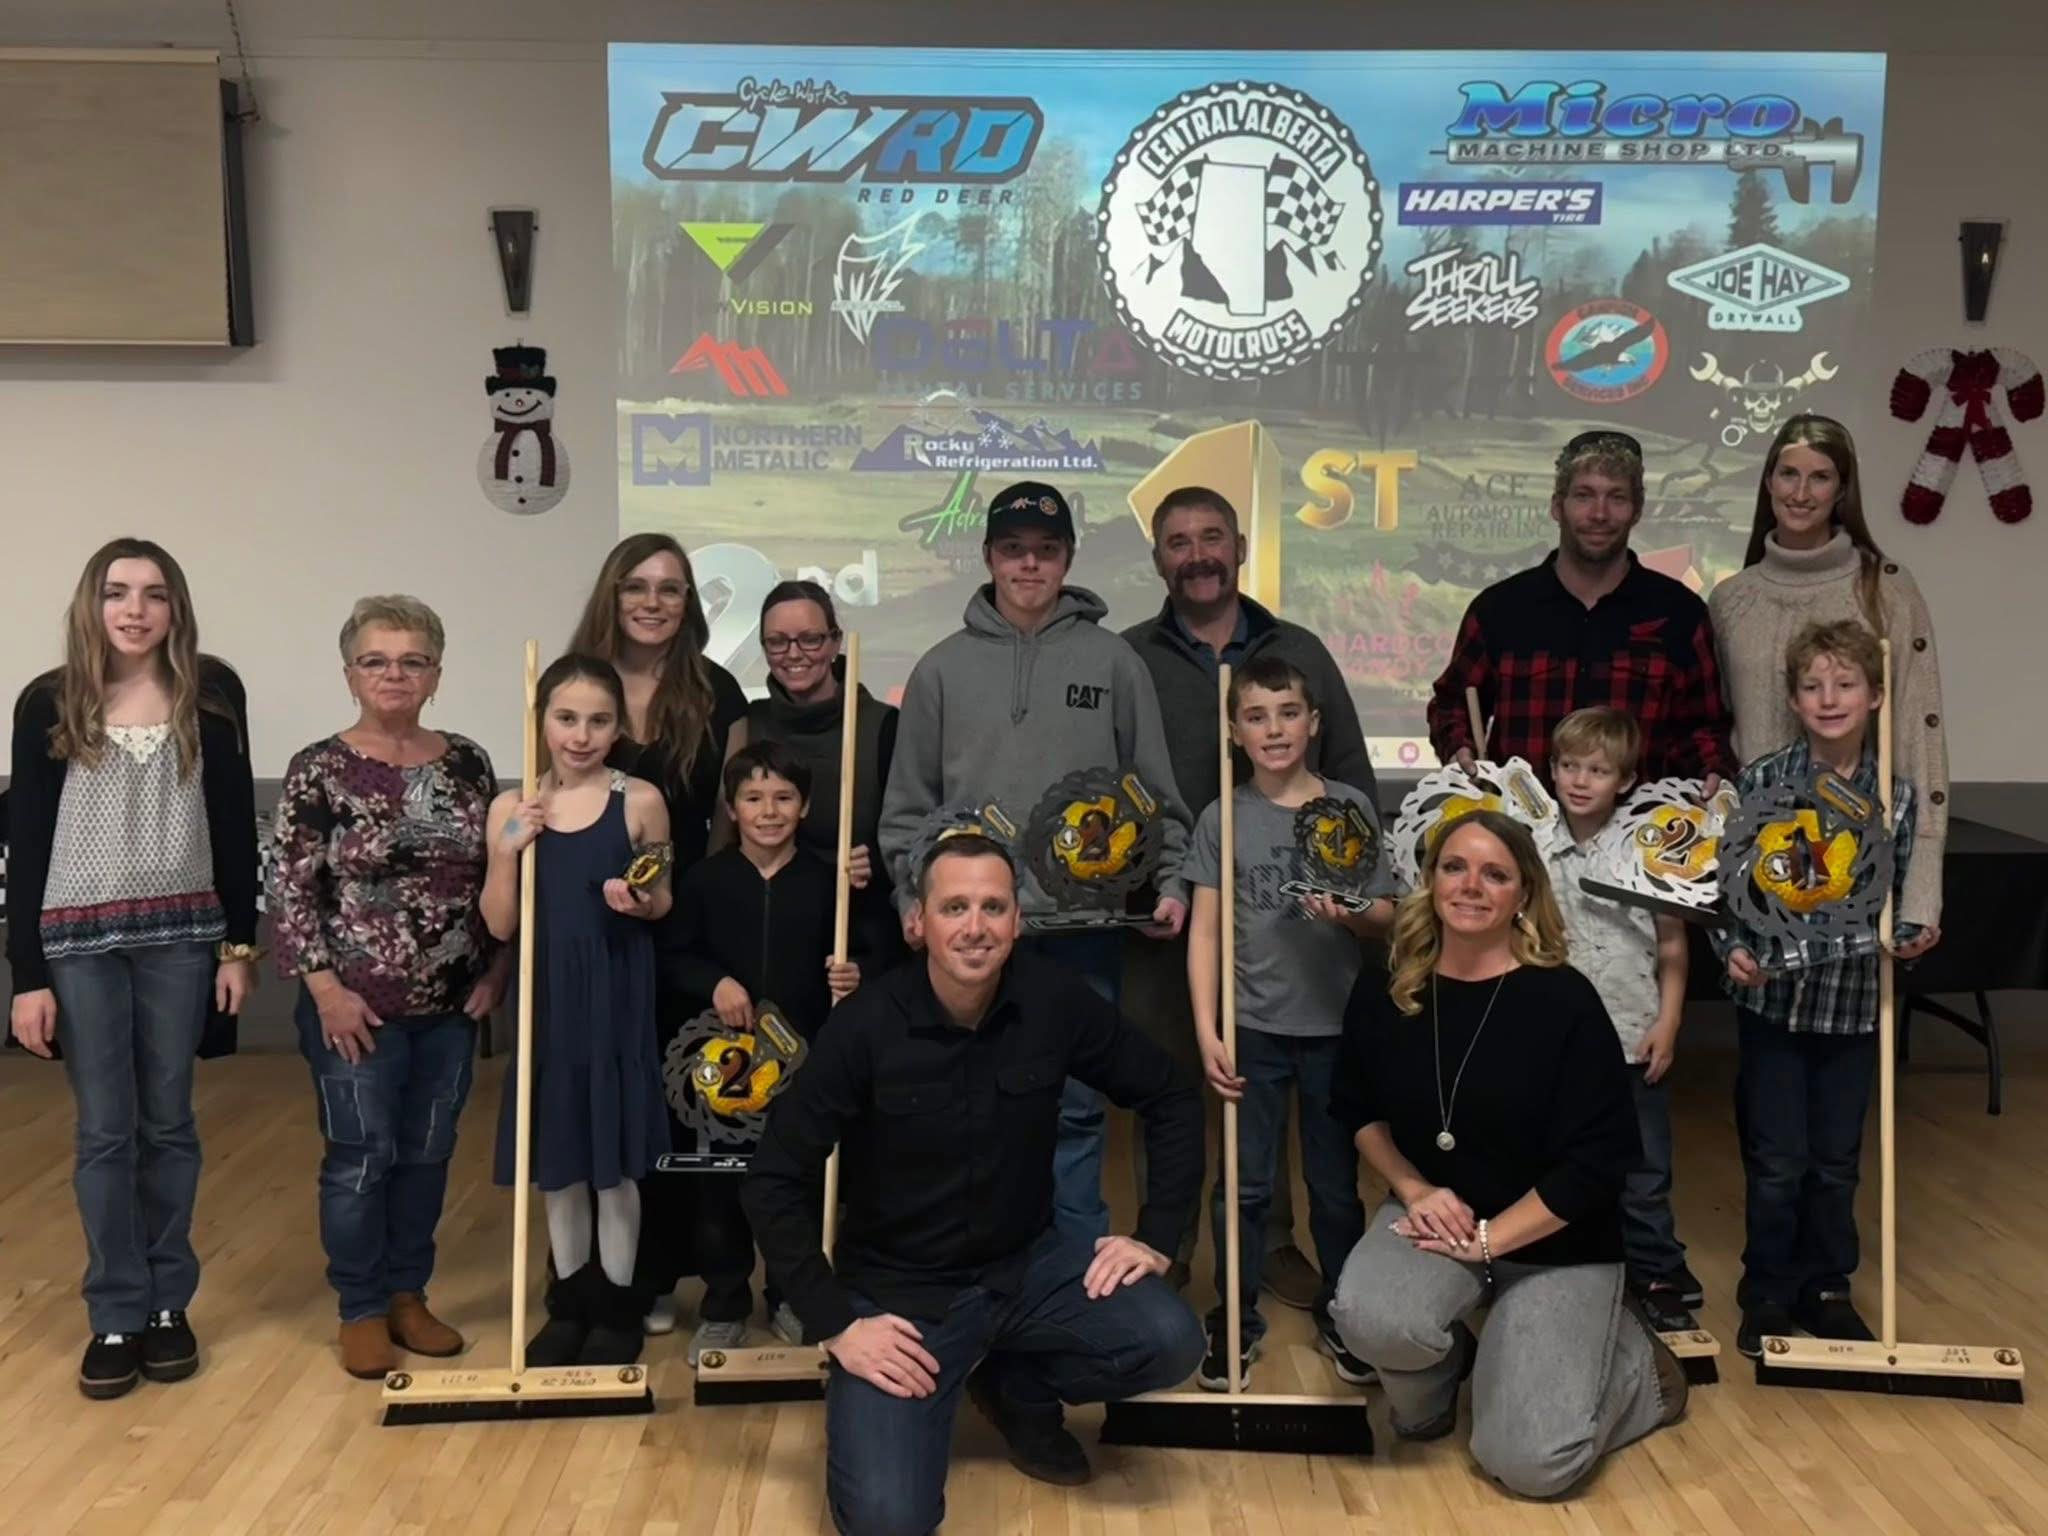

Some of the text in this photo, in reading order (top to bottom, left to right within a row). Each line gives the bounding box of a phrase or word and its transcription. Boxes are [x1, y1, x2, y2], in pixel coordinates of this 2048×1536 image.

[1446, 79, 1800, 138] Micro
[1139, 101, 1343, 177] CENTRAL ALBERTA
[1456, 142, 1795, 158] MACHINE SHOP LTD.
[857, 187, 1013, 205] RED DEER
[1403, 187, 1596, 212] HARPER'S
[1552, 213, 1584, 223] TIRE
[1706, 264, 1809, 300] JOE HAY
[730, 299, 813, 315] VISION
[1405, 290, 1539, 332] SEEKERS
[1713, 311, 1797, 326] DRYWALL
[872, 317, 1138, 373] DELTA
[1164, 310, 1309, 359] MOTOCROSS
[1006, 381, 1143, 400] SERVICES
[713, 424, 863, 446] NORTHERN
[713, 450, 829, 471] METALIC
[904, 433, 976, 467] Rocky
[935, 454, 1099, 471] Refrigeration Ltd.
[1426, 505, 1552, 521] AUTOMOTIV
[1065, 683, 1103, 710] CAT
[717, 1046, 753, 1099] 2
